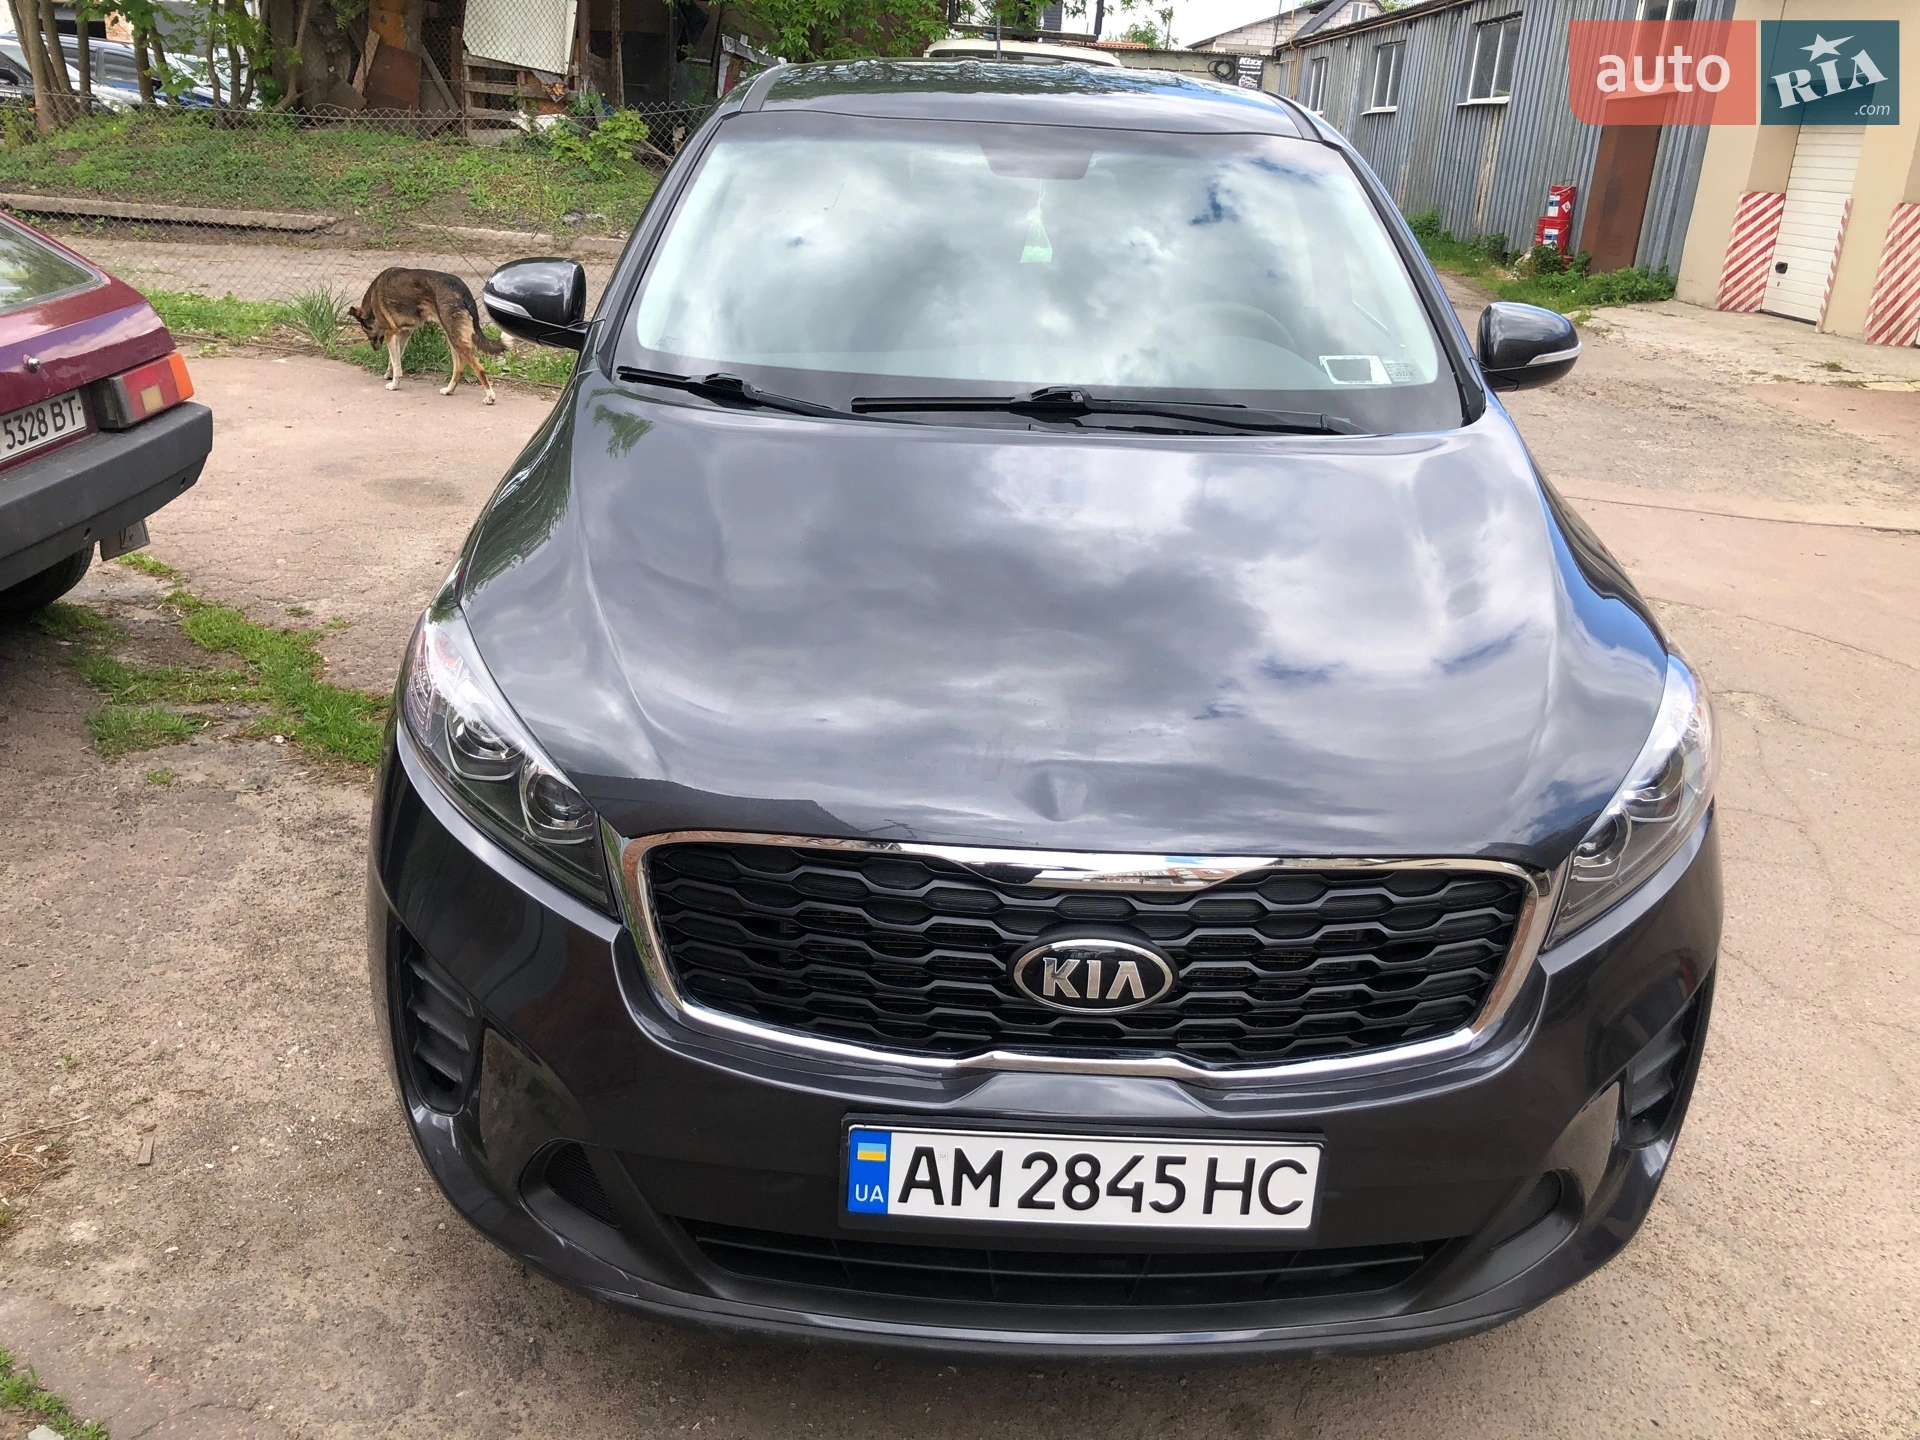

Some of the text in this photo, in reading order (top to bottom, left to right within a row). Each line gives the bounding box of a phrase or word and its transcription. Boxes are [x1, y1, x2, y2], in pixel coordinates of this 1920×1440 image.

[3, 395, 76, 450] 5328 BT
[1042, 957, 1146, 999] KIA
[855, 1184, 885, 1203] UA
[897, 1146, 1308, 1217] AM 2845 HC
